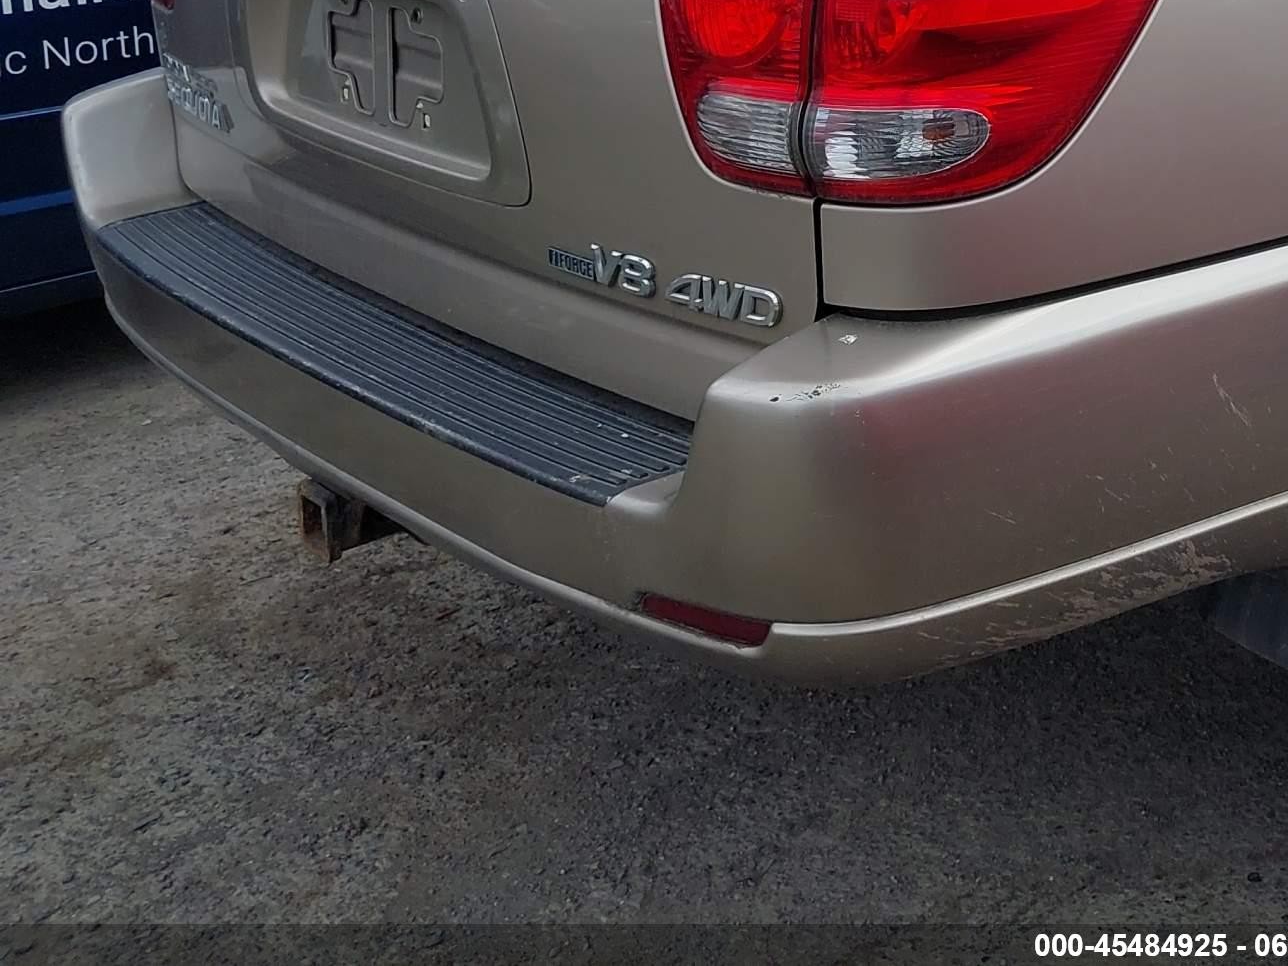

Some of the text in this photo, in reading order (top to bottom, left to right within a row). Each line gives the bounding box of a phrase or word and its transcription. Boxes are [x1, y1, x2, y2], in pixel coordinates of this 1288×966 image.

[42, 25, 155, 70] North
[590, 242, 656, 297] V8
[665, 273, 783, 329] 4WD
